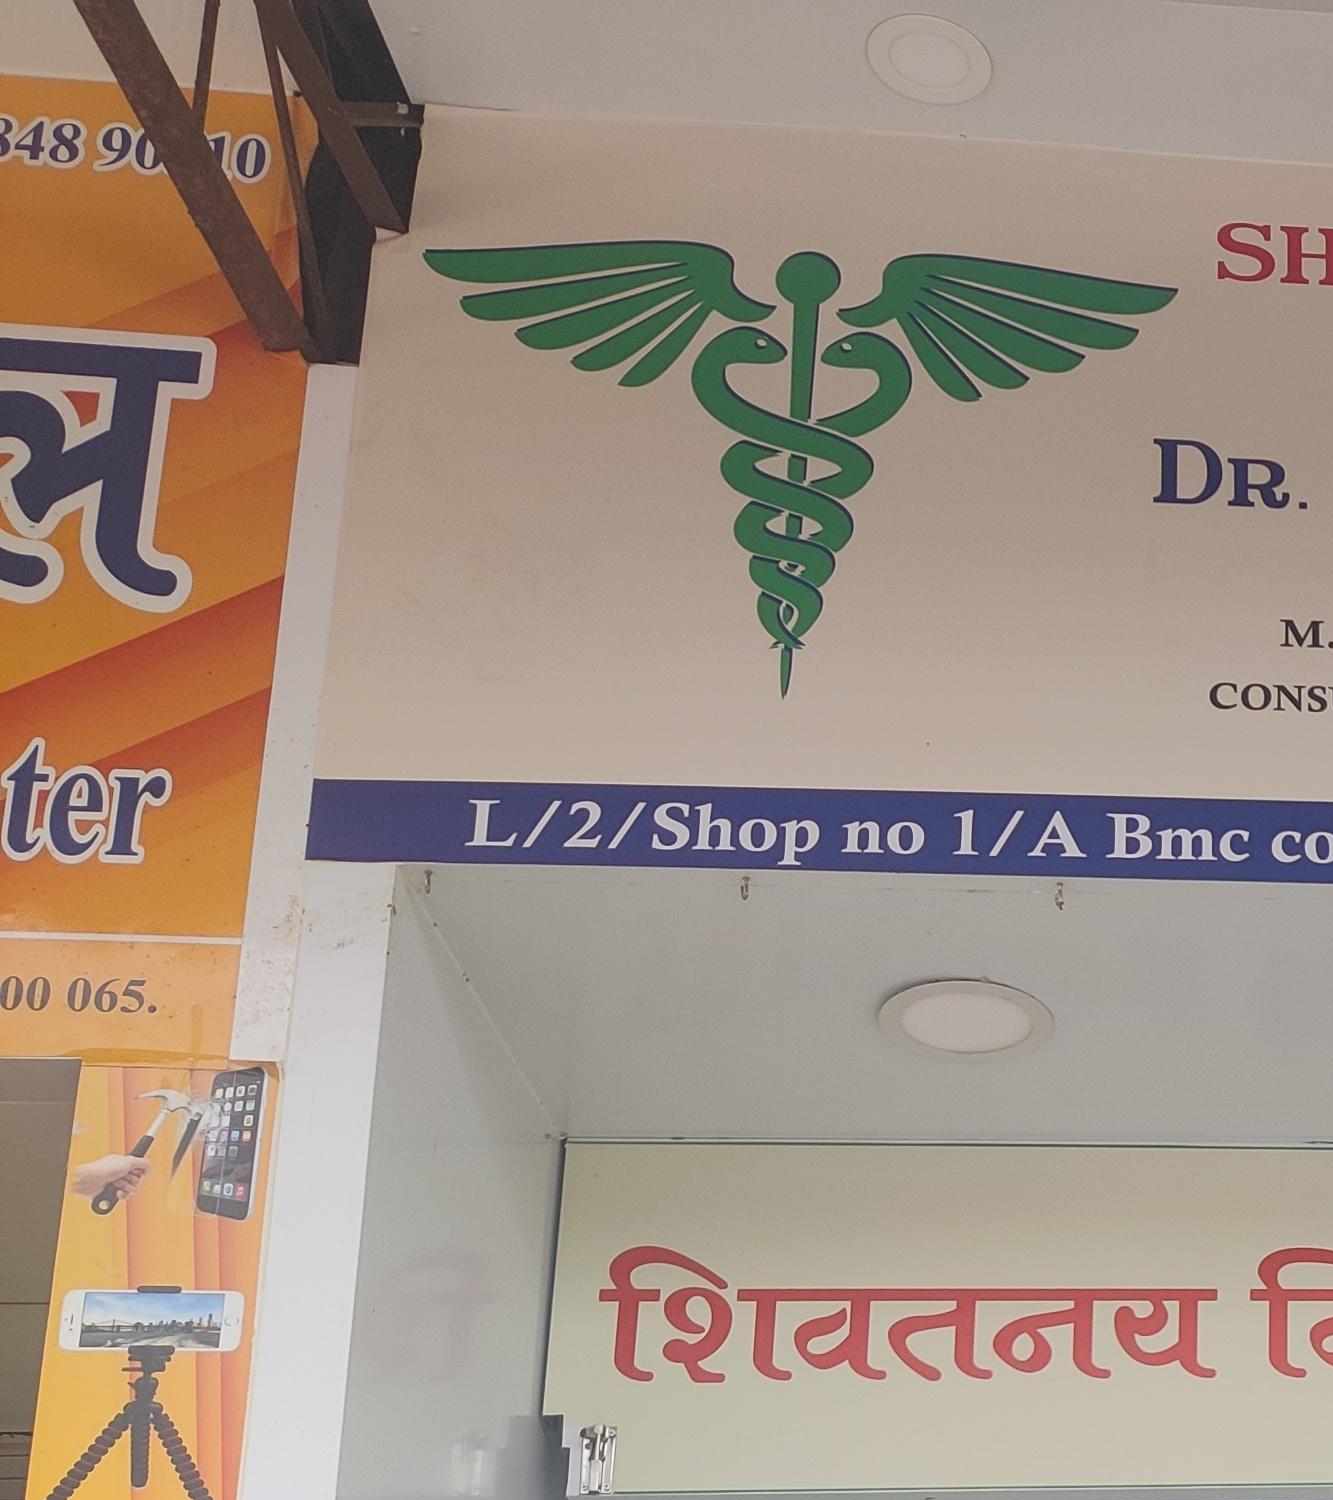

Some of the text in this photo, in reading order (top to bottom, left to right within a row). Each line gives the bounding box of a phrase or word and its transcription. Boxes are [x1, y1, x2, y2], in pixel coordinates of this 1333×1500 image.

[465, 798, 820, 864] L/2/Shop
[843, 818, 926, 856] no
[953, 809, 1087, 859] 1/A
[1106, 812, 1251, 863] Bmc
[68, 978, 157, 1013] 065.
[599, 1245, 1218, 1383] शिवतनय
